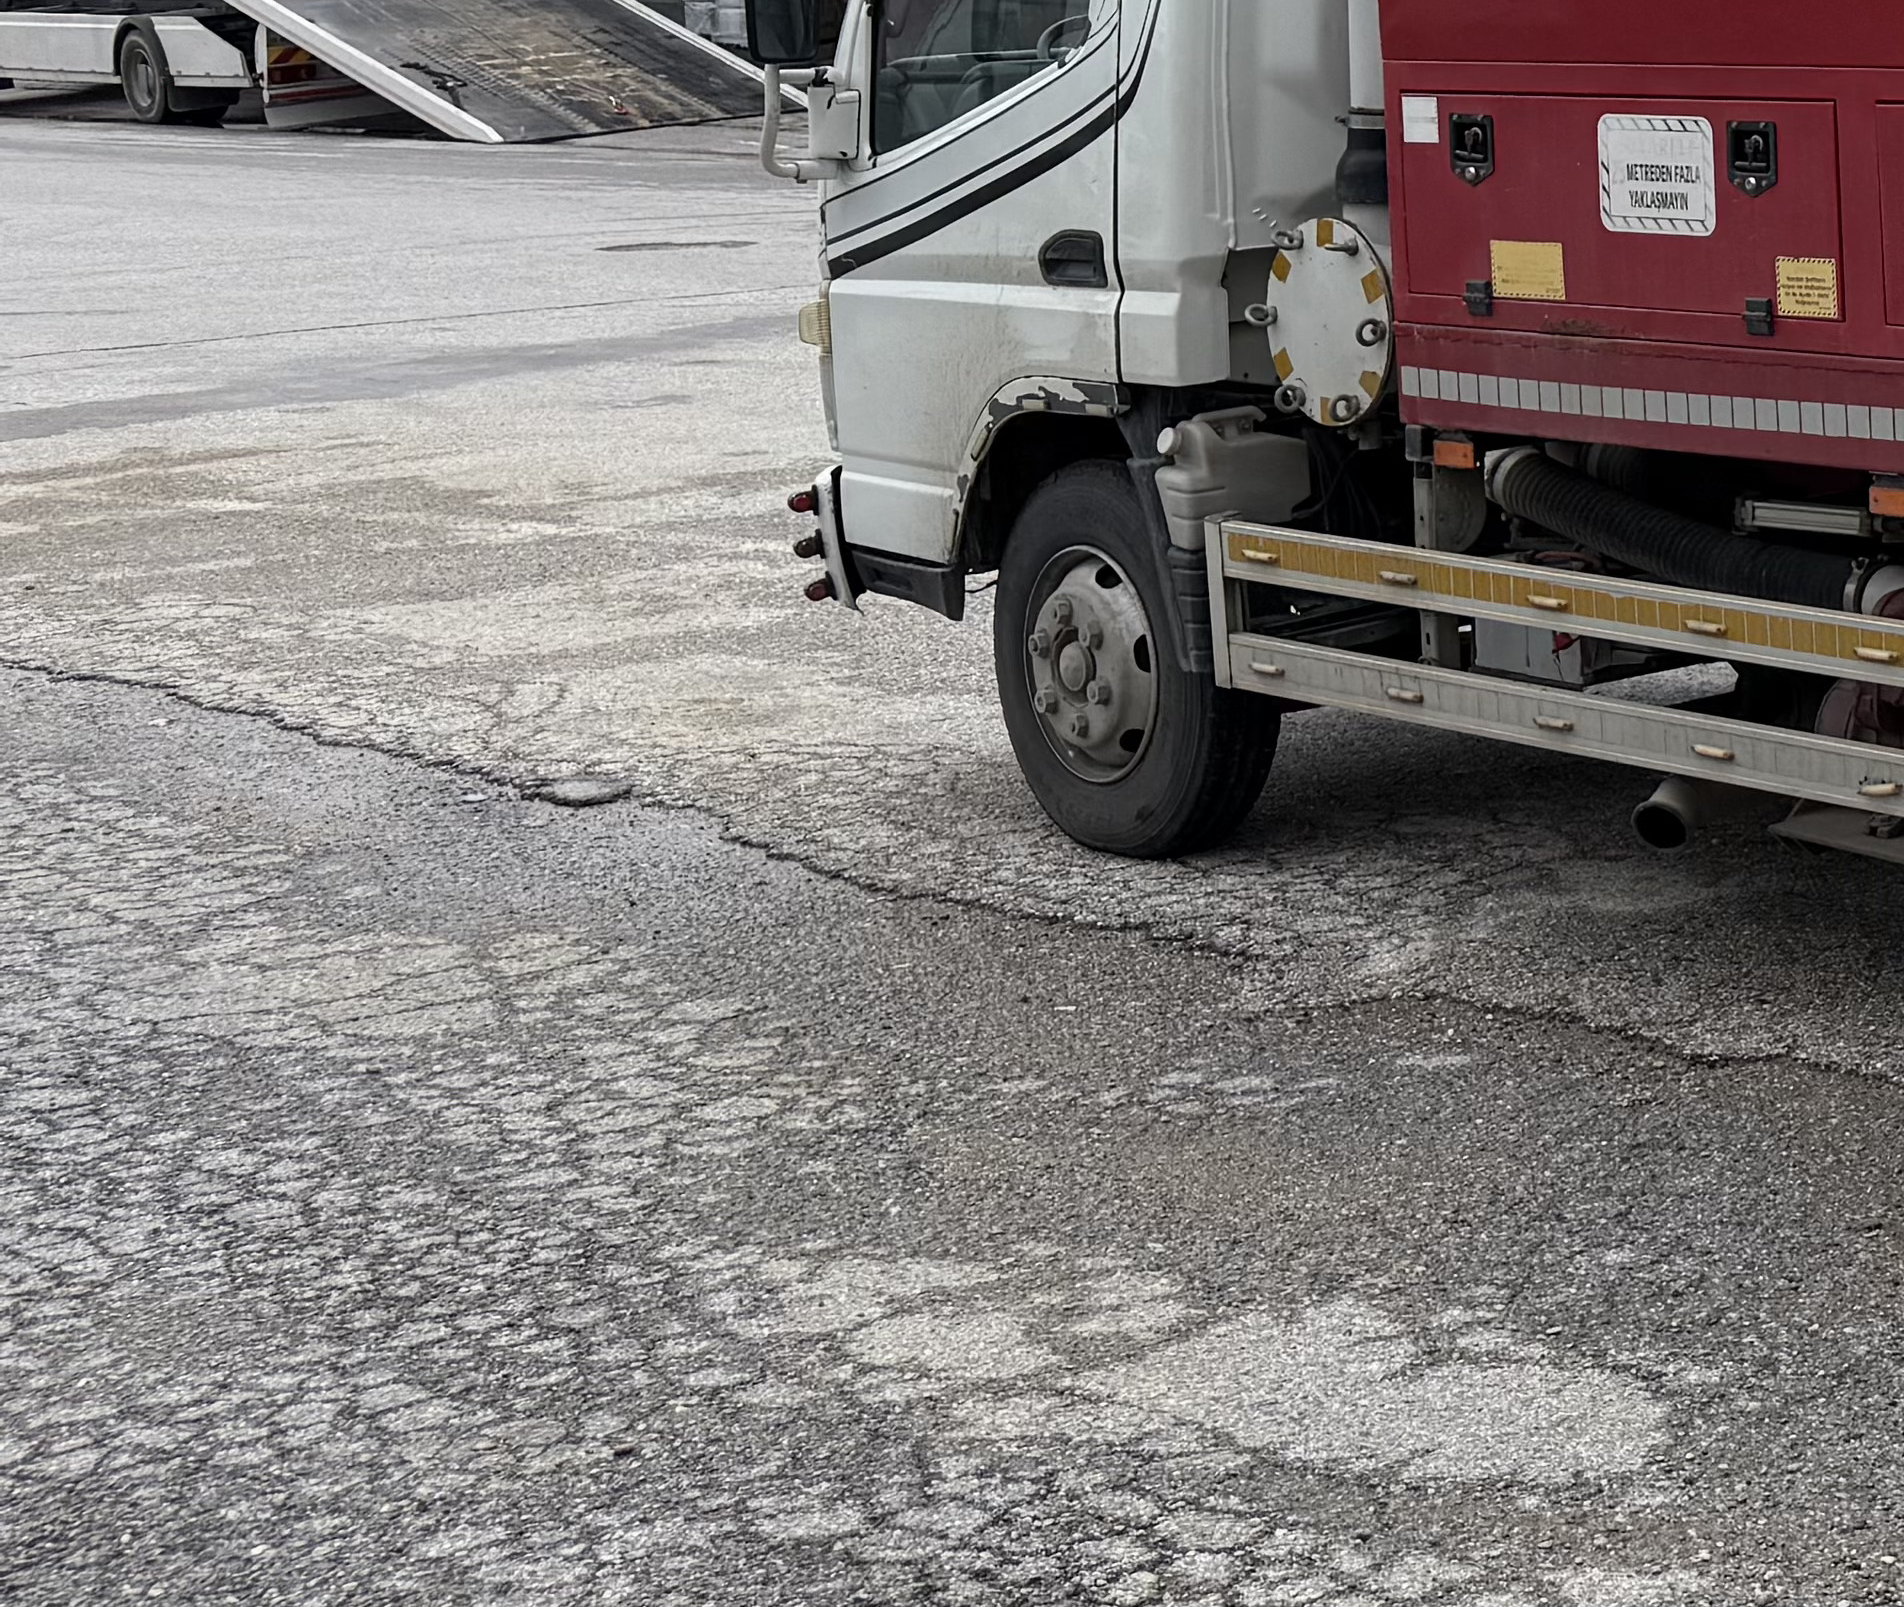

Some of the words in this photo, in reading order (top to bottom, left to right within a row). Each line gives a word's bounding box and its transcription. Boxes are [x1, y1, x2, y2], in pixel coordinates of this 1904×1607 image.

[1626, 163, 1673, 183] METREDEN
[1674, 165, 1702, 184] FAZLA
[1628, 190, 1689, 213] YAKLAŞMAYIN
